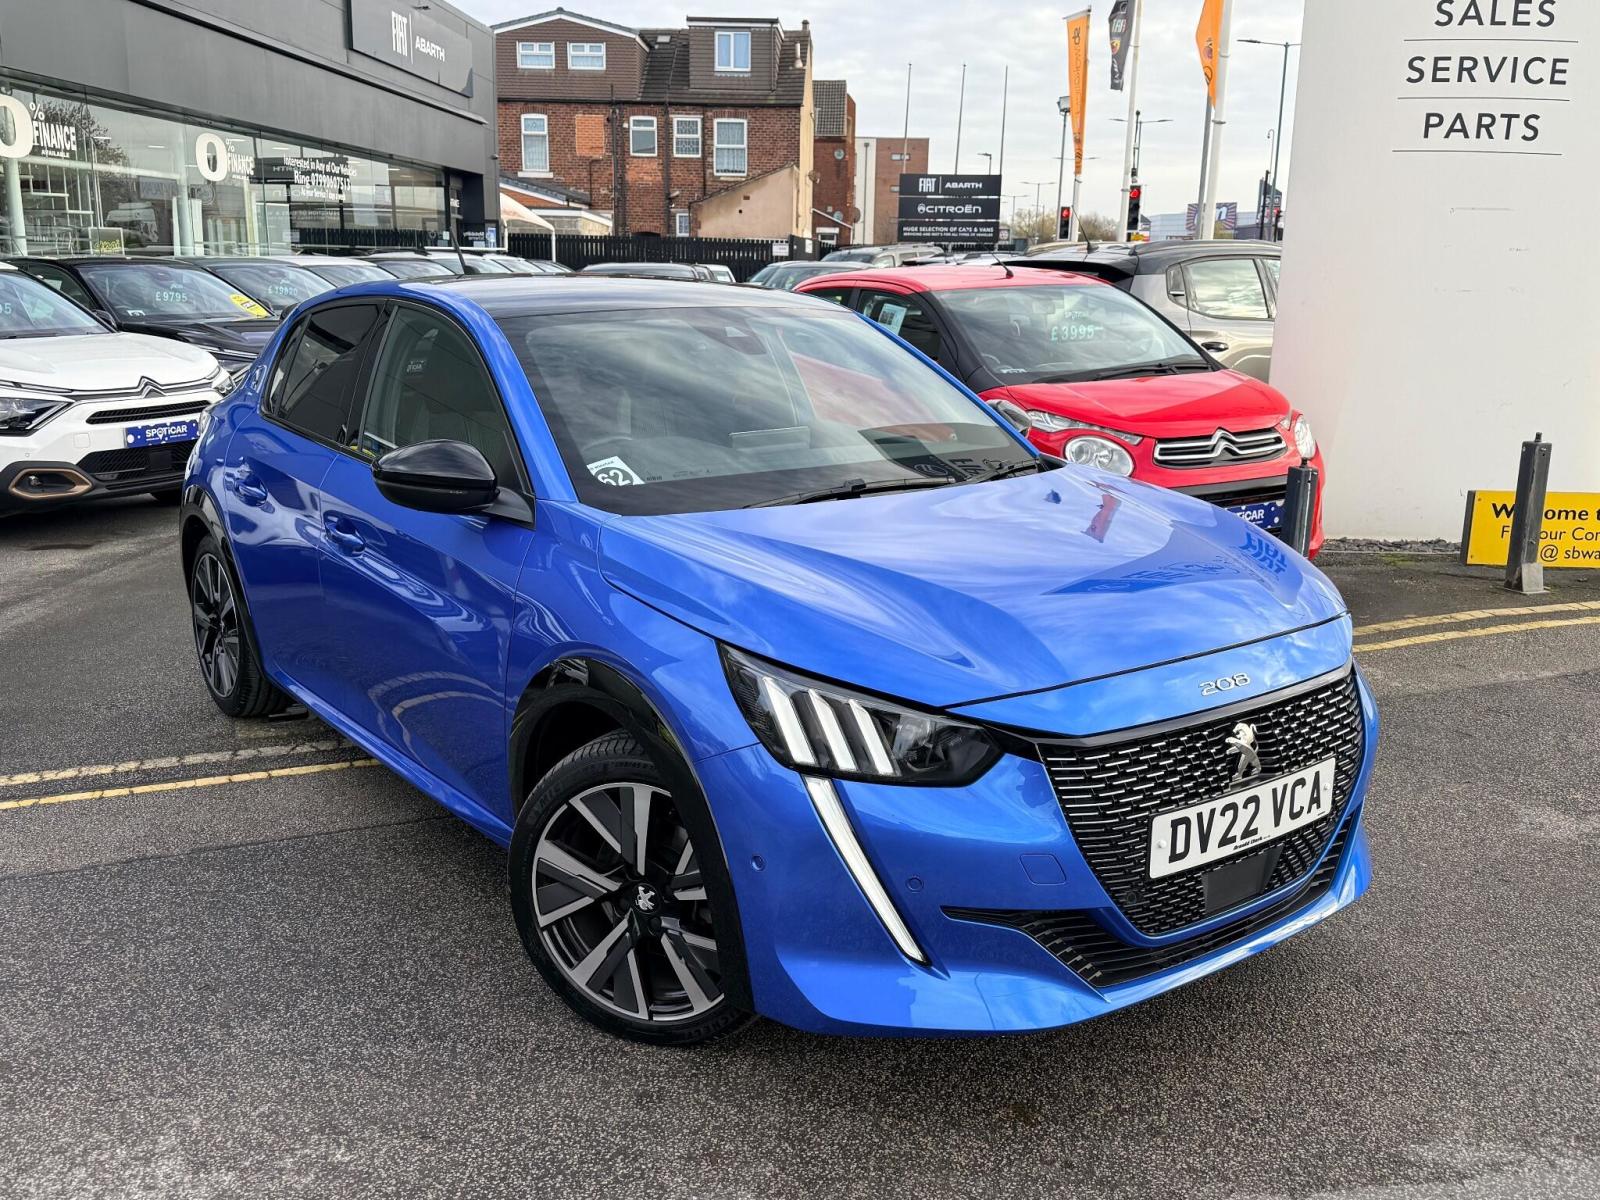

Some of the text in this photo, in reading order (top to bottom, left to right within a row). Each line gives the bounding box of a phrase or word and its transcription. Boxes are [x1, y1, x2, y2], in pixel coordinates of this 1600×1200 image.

[1434, 0, 1556, 27] SALES
[391, 10, 446, 62] FIAT ABARTH
[1405, 55, 1570, 85] SERVICE
[32, 120, 77, 151] FINANCE
[1423, 112, 1541, 141] PARTS
[227, 152, 255, 176] FINANCE
[283, 154, 310, 168] Interested
[316, 159, 325, 174] Any
[331, 161, 340, 174] Our
[294, 169, 310, 189] Ring
[918, 178, 937, 193] FIAT
[926, 204, 982, 214] CITROËN
[155, 291, 188, 302] £9795
[1051, 324, 1095, 341] £3995
[145, 424, 188, 440] SPOTiCAR
[1491, 502, 1589, 520] Wome
[1540, 544, 1559, 562] @
[1199, 671, 1251, 696] 208
[1168, 770, 1322, 865] DV22 VCA
